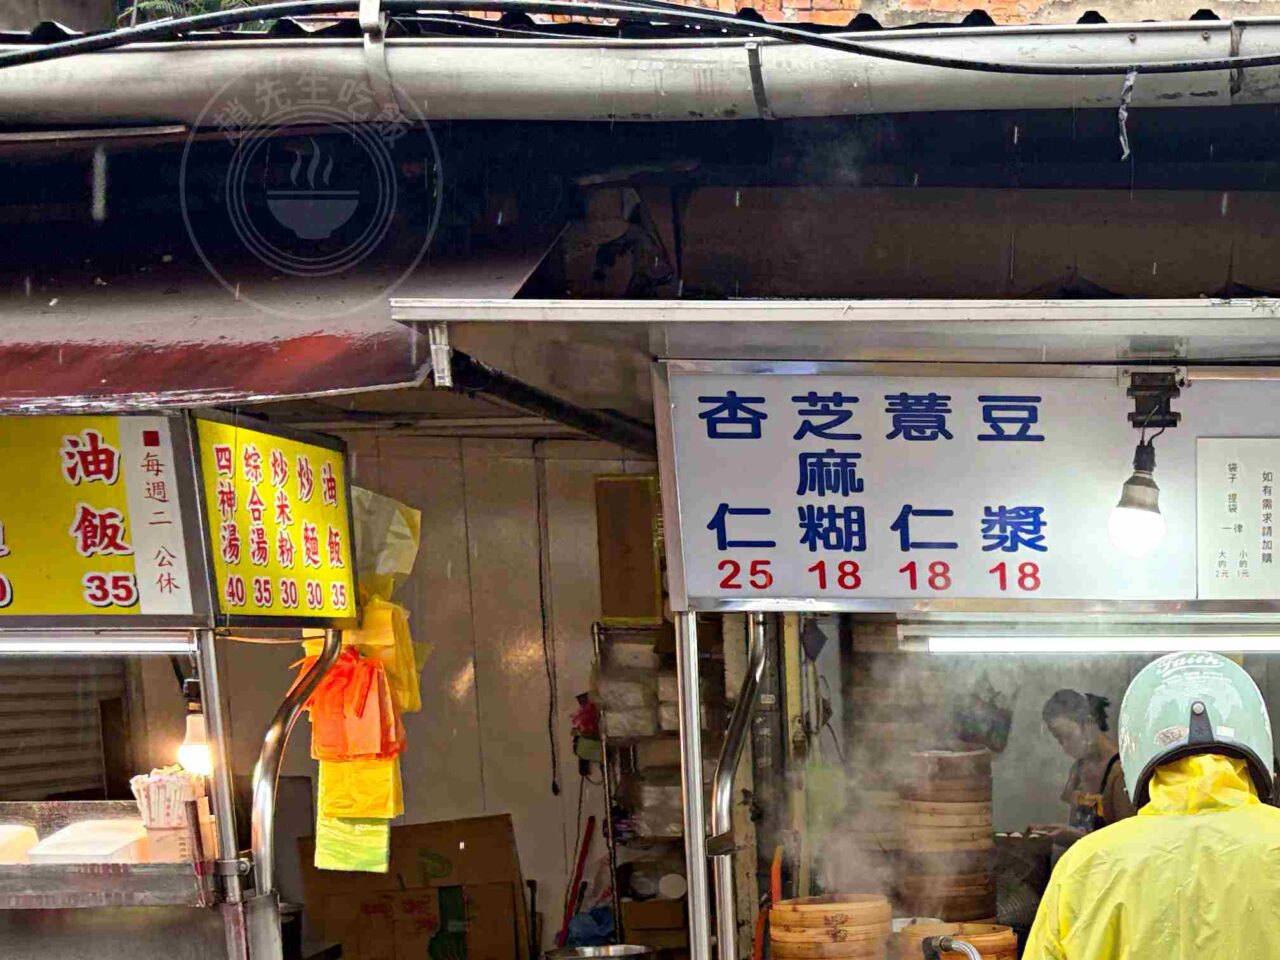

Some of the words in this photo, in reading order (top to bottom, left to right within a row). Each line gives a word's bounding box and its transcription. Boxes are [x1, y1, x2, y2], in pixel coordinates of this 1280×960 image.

[64, 431, 130, 552] 油飯
[140, 451, 173, 525] 每週二
[697, 390, 777, 552] 杏仁
[791, 390, 868, 553] 芝麻糊
[884, 391, 959, 553] 薏仁
[976, 394, 1049, 553] 豆漿
[215, 446, 240, 561] 四神湯
[243, 446, 268, 563] 綜合湯
[271, 450, 295, 565] 炒米粉
[297, 456, 320, 565] 炒麵
[322, 462, 343, 566] 油飯
[86, 575, 134, 602] 35
[154, 545, 181, 594] 公休
[226, 576, 244, 604] 40
[254, 578, 272, 604] 35
[281, 580, 297, 604] 30
[307, 581, 322, 606] 30
[332, 583, 347, 607] 35
[717, 560, 774, 590] 25
[807, 560, 862, 590] 18
[898, 560, 953, 591] 18
[988, 561, 1041, 592] 18
